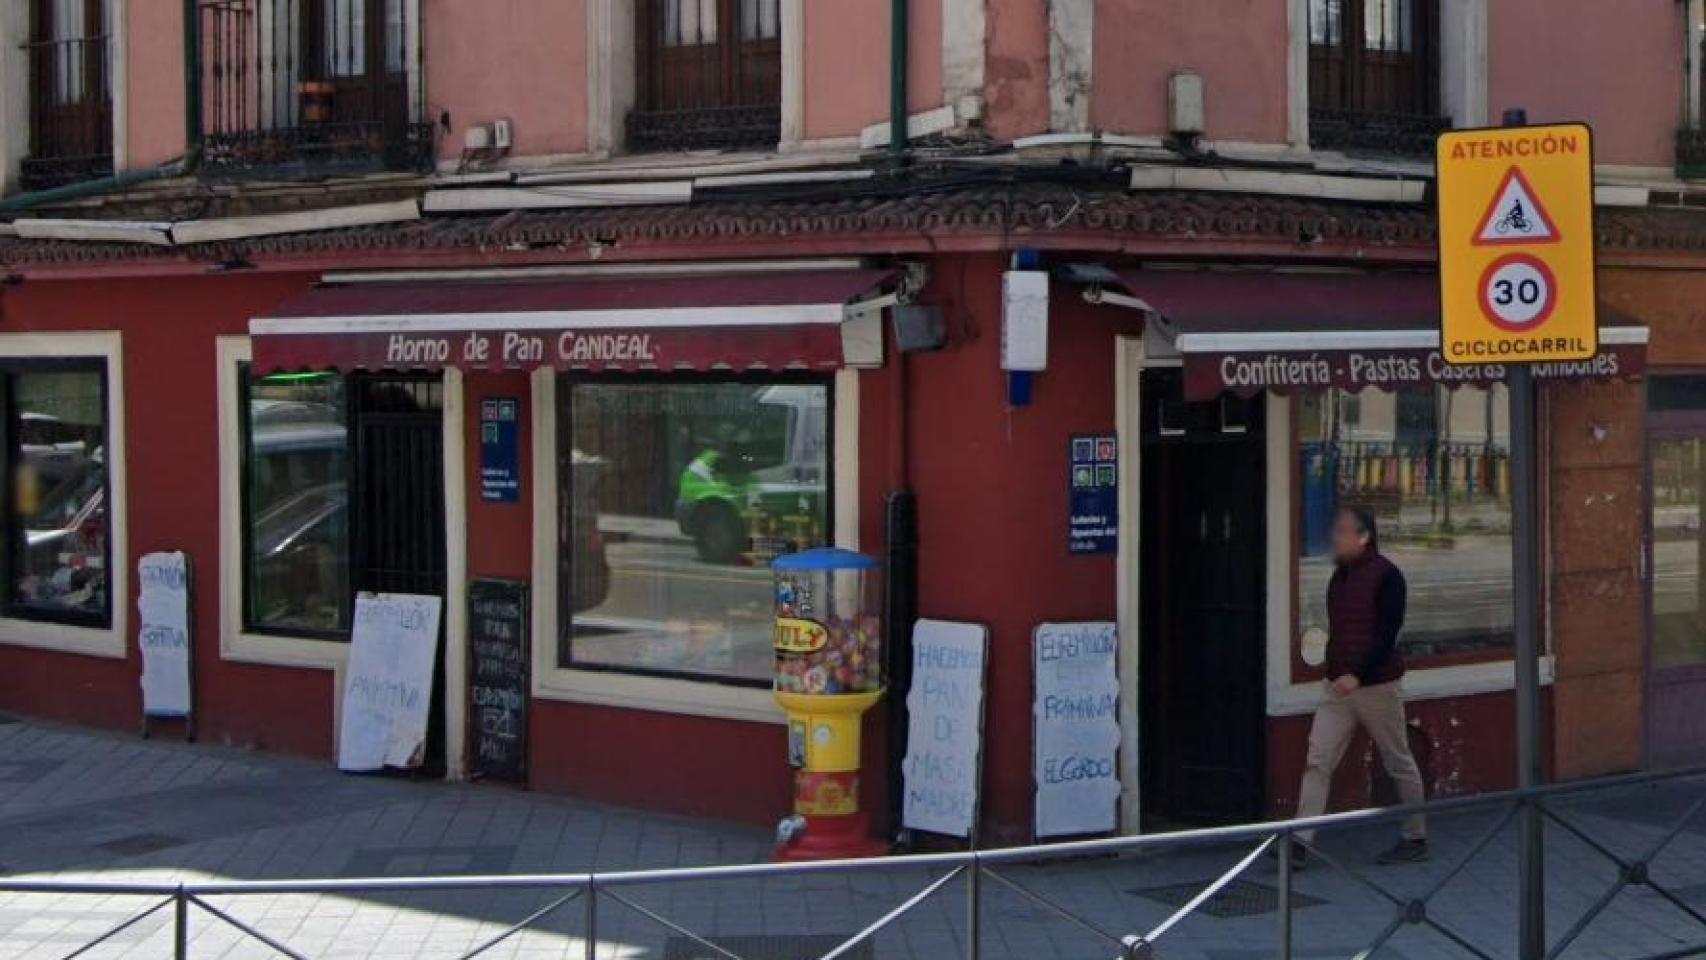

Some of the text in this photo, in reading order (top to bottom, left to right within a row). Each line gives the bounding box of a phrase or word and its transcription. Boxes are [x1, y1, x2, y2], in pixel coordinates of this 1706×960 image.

[1451, 133, 1577, 160] ATENCIÓN
[1494, 279, 1540, 304] 30
[387, 334, 448, 361] Horno
[464, 332, 489, 361] de
[503, 332, 544, 361] Pan
[1452, 338, 1588, 356] CICLOCARRIL
[1220, 354, 1330, 386] Confitería
[1351, 355, 1420, 382] Pastas
